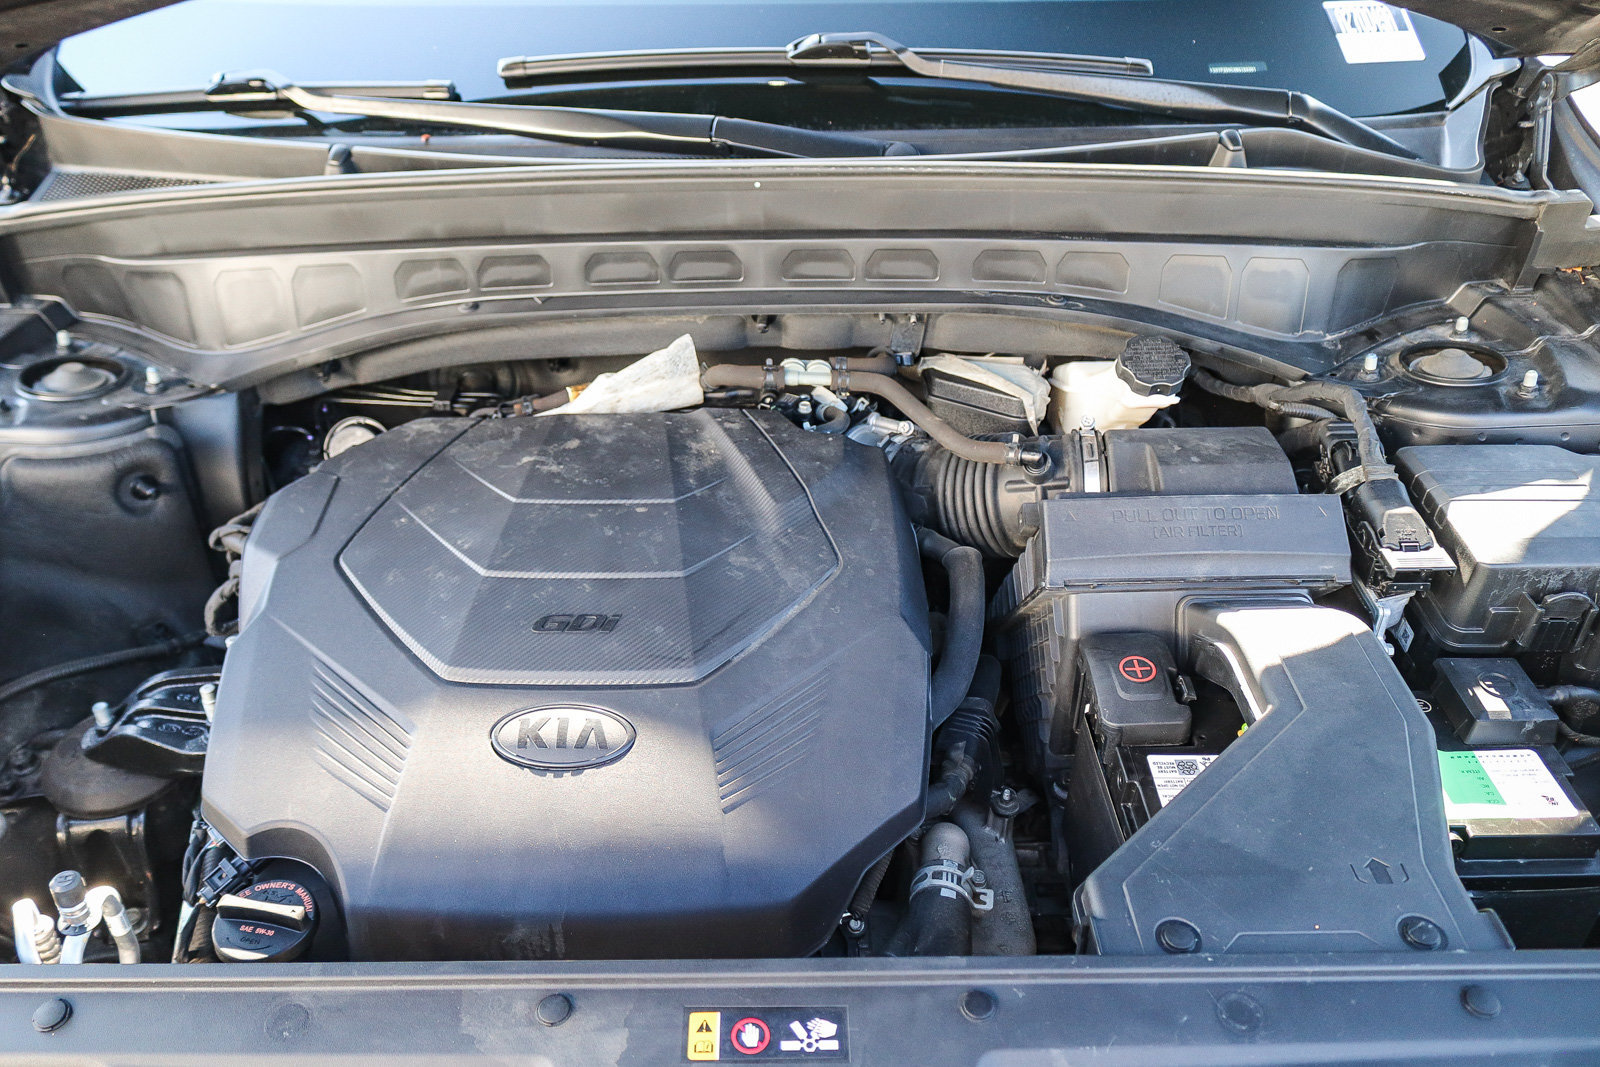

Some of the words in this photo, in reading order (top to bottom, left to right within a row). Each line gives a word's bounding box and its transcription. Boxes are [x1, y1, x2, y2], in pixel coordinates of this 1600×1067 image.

[1112, 509, 1157, 523] PULL
[1162, 507, 1198, 522] OUT
[1201, 506, 1227, 521] TO
[1231, 505, 1280, 521] OPEN
[517, 717, 609, 749] KIA
[254, 881, 296, 892] OWNER'S
[240, 925, 254, 933] SAE
[255, 927, 275, 936] 5W-30
[240, 936, 261, 945] OPEN
